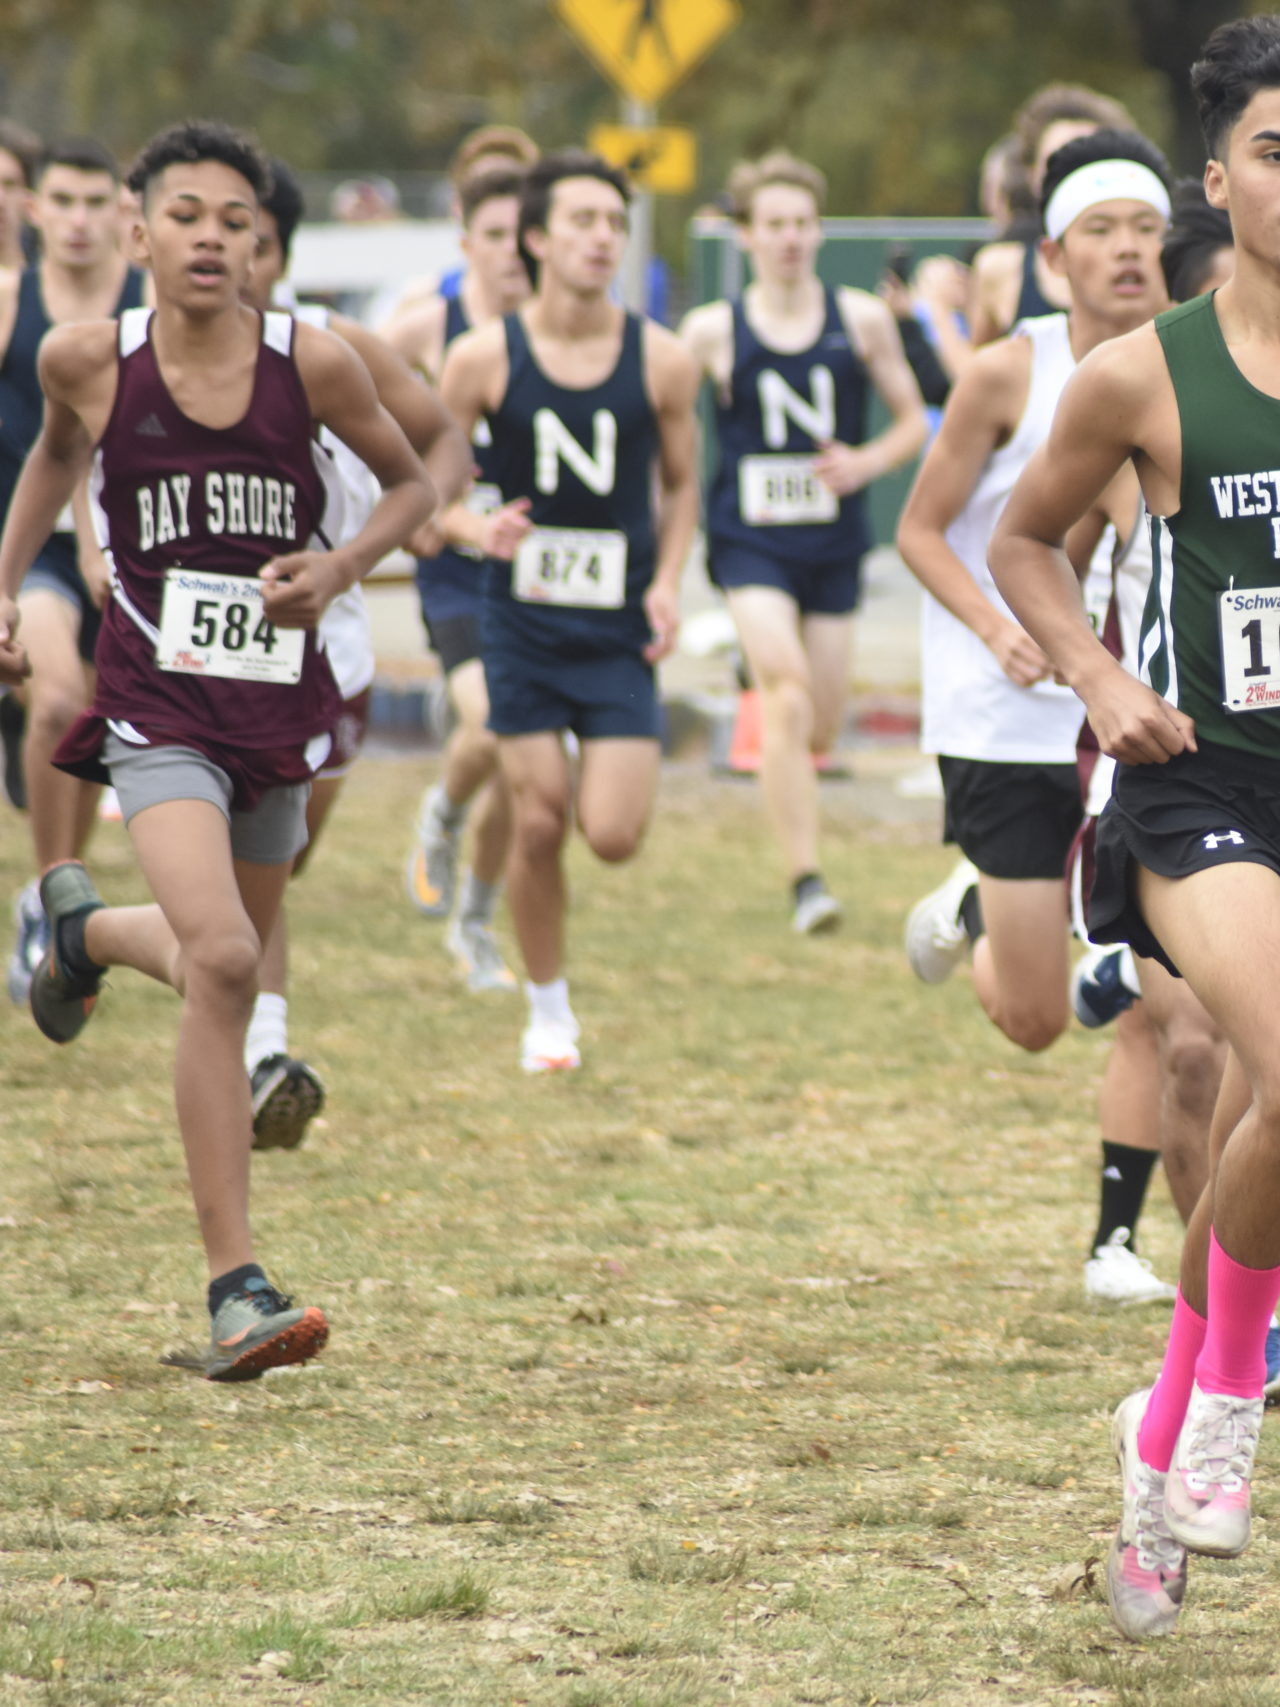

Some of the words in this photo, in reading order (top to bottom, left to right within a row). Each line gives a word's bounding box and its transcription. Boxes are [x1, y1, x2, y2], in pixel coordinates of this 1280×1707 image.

[757, 363, 836, 449] N
[533, 407, 619, 496] N
[137, 474, 191, 551] BAY
[206, 471, 296, 540] SHORE
[178, 576, 239, 595] Schwab's
[241, 583, 262, 597] 2n
[540, 551, 601, 584] 874
[191, 600, 277, 653] 584
[1245, 682, 1267, 703] 2nd
